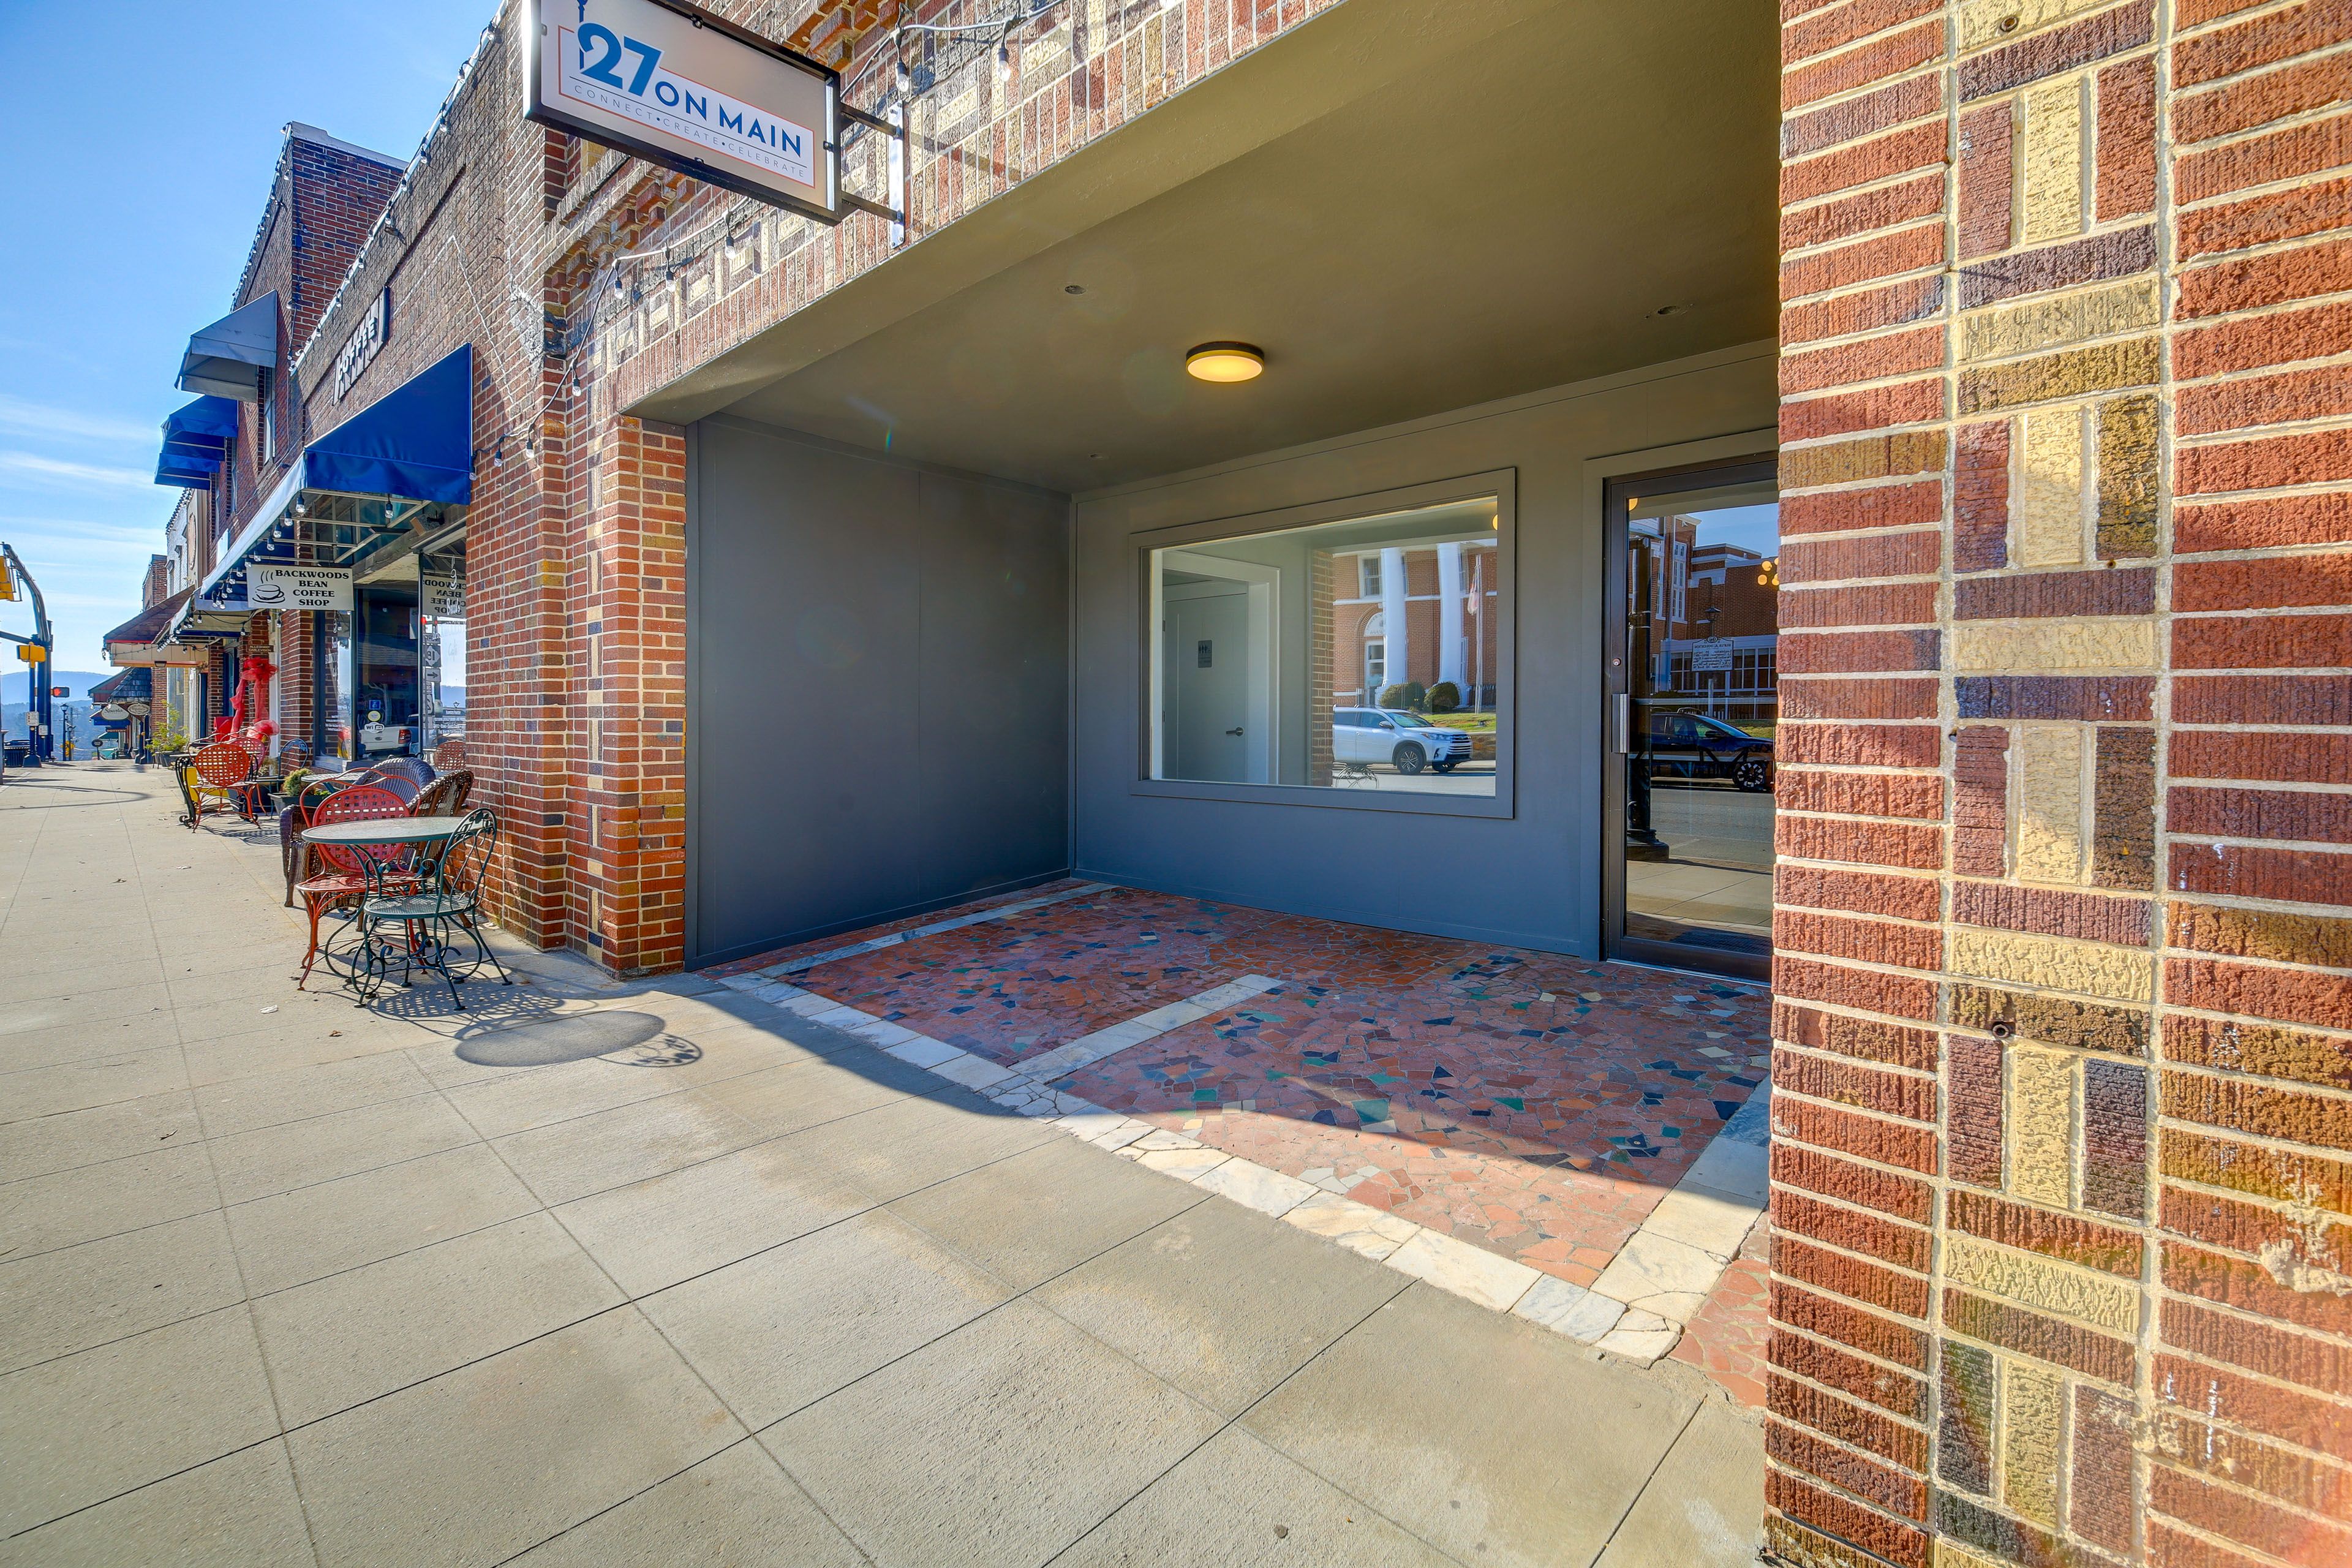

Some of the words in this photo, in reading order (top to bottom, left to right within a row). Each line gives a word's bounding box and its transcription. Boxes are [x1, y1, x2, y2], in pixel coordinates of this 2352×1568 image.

[577, 22, 663, 97] 27
[655, 81, 707, 122] ON
[720, 104, 801, 158] MAIN
[575, 85, 653, 120] CONNECT
[663, 118, 720, 146] CREATE
[728, 143, 805, 179] CELEBRATE
[338, 317, 377, 381] COFFEE
[276, 570, 349, 579] BACKWOODS
